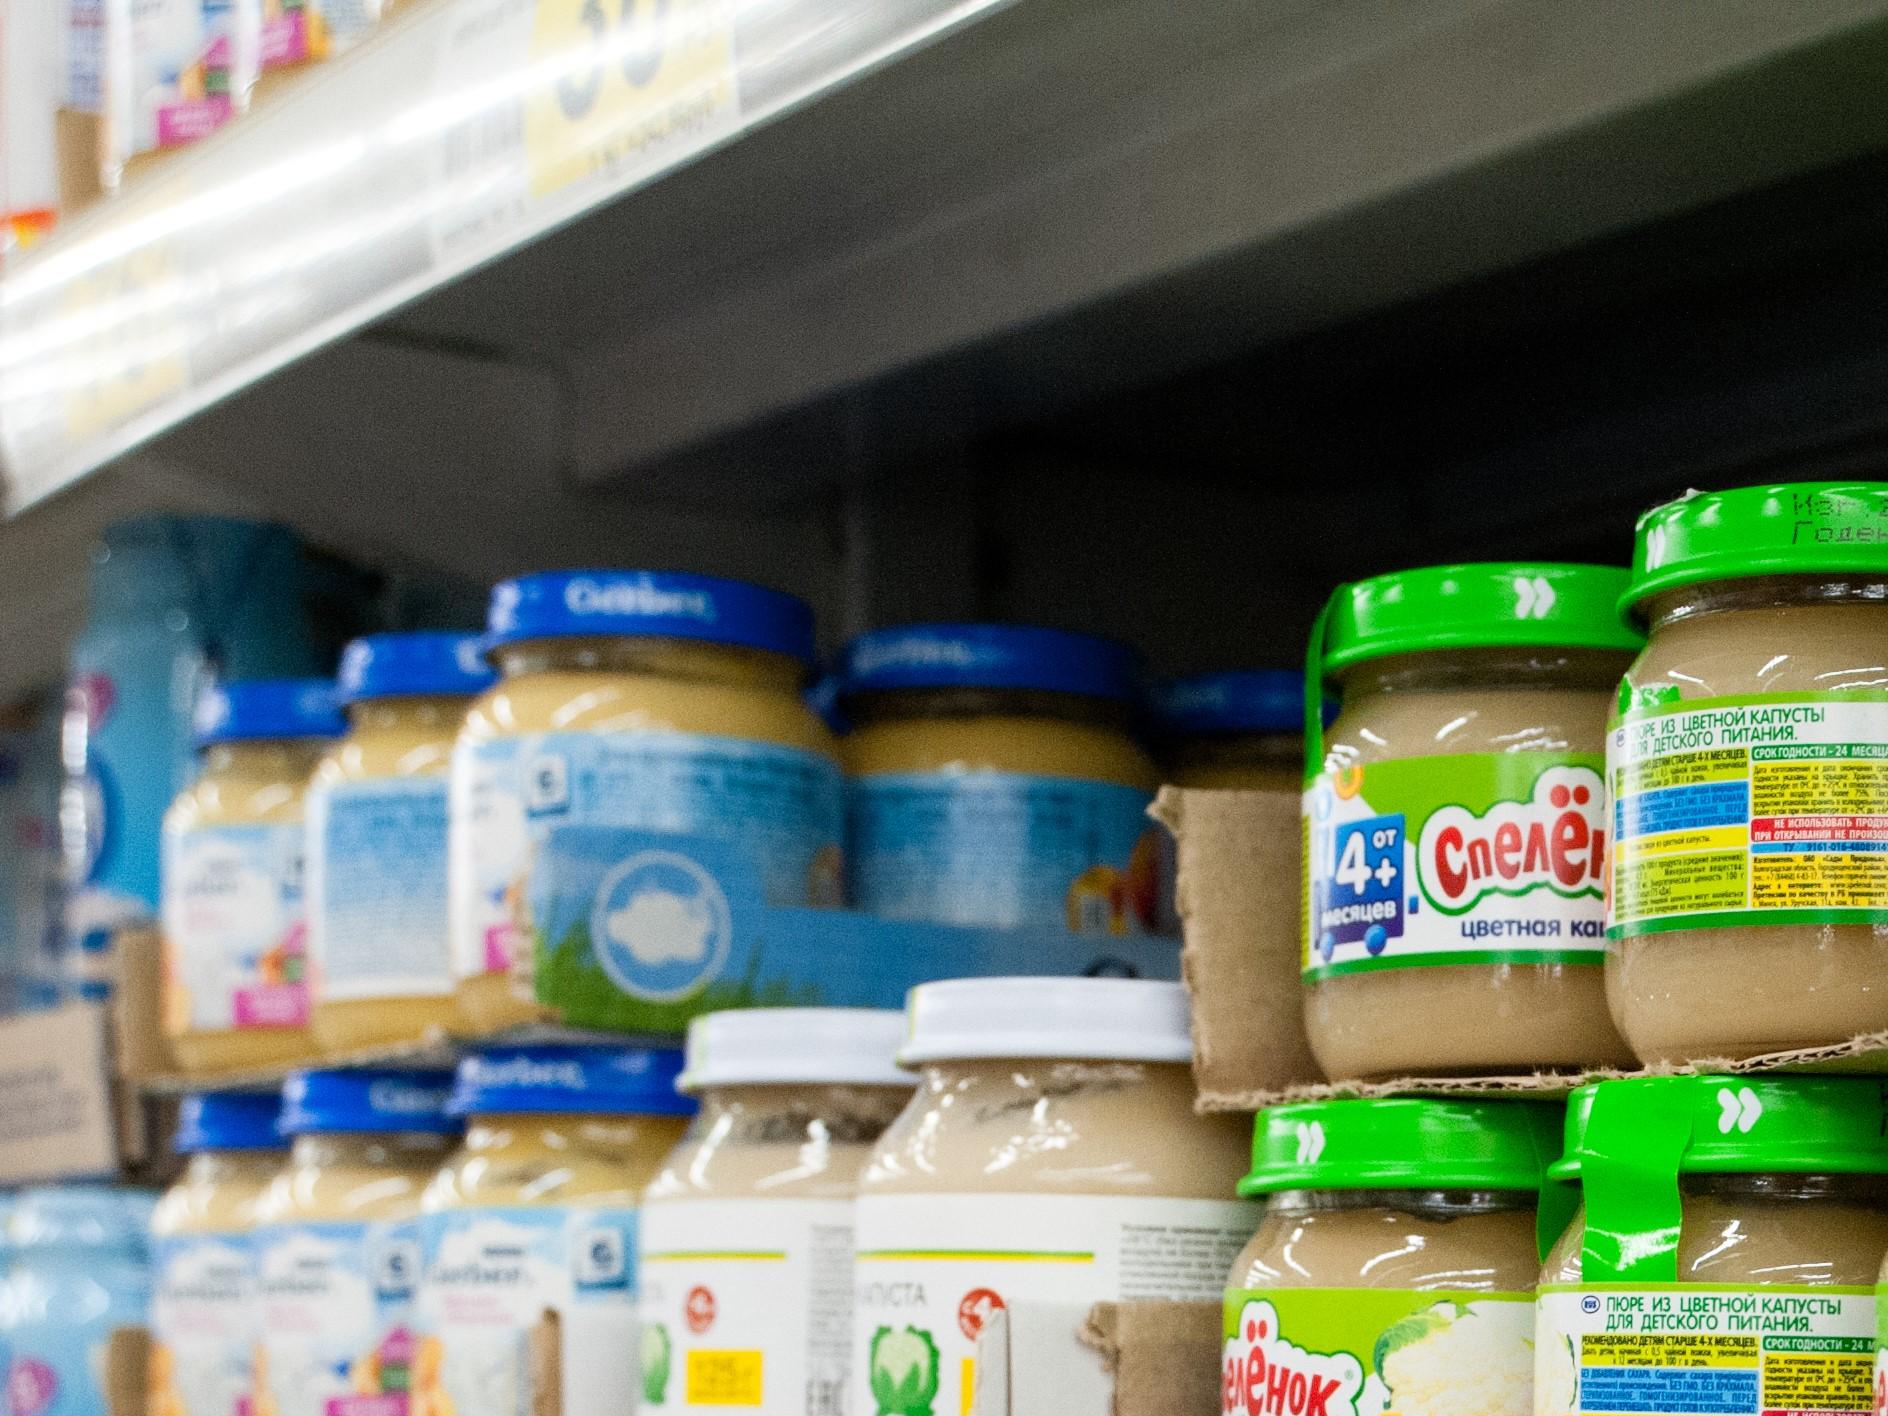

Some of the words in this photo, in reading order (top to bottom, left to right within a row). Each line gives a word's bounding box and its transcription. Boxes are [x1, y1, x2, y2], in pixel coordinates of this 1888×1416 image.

[1661, 718, 1675, 734] ИЗ
[1683, 706, 1747, 732] ЦВЕТНОЙ
[1750, 707, 1825, 726] КАПУСТЫ
[1652, 732, 1713, 753] ДЕТСКОГО
[1721, 725, 1798, 745] ПИТАНИЯ.
[1754, 748, 1776, 758] СРОК
[1778, 746, 1827, 758] ГОДНОСТИ
[1835, 746, 1847, 756] 24
[1774, 820, 1784, 829] НЕ
[1788, 820, 1852, 829] ИСПОЛЬЗОВАТЬ
[1373, 829, 1397, 848] от
[1754, 832, 1771, 841] ПРИ
[1774, 831, 1831, 840] ОТКРЫВАНИИ
[1835, 830, 1846, 839] НЕ
[1322, 901, 1397, 928] месяцев
[1461, 919, 1561, 940] цветная
[1606, 1297, 1644, 1312] ПЮРЕ
[1653, 1297, 1671, 1312] ИЗ
[1680, 1292, 1756, 1317] ЦВЕТНОЙ
[1762, 1298, 1841, 1315] КАПУСТЫ
[1606, 1314, 1633, 1332] ДЛЯ
[1641, 1314, 1718, 1332] ДЕТСКОГО
[1729, 1314, 1814, 1332] ПИТАНИЯ.
[1666, 1336, 1697, 1346] СТАРШЕ
[1766, 1339, 1790, 1348] СРОК
[1792, 1339, 1842, 1351] ГОДНОСТИ
[1851, 1340, 1863, 1350] 24
